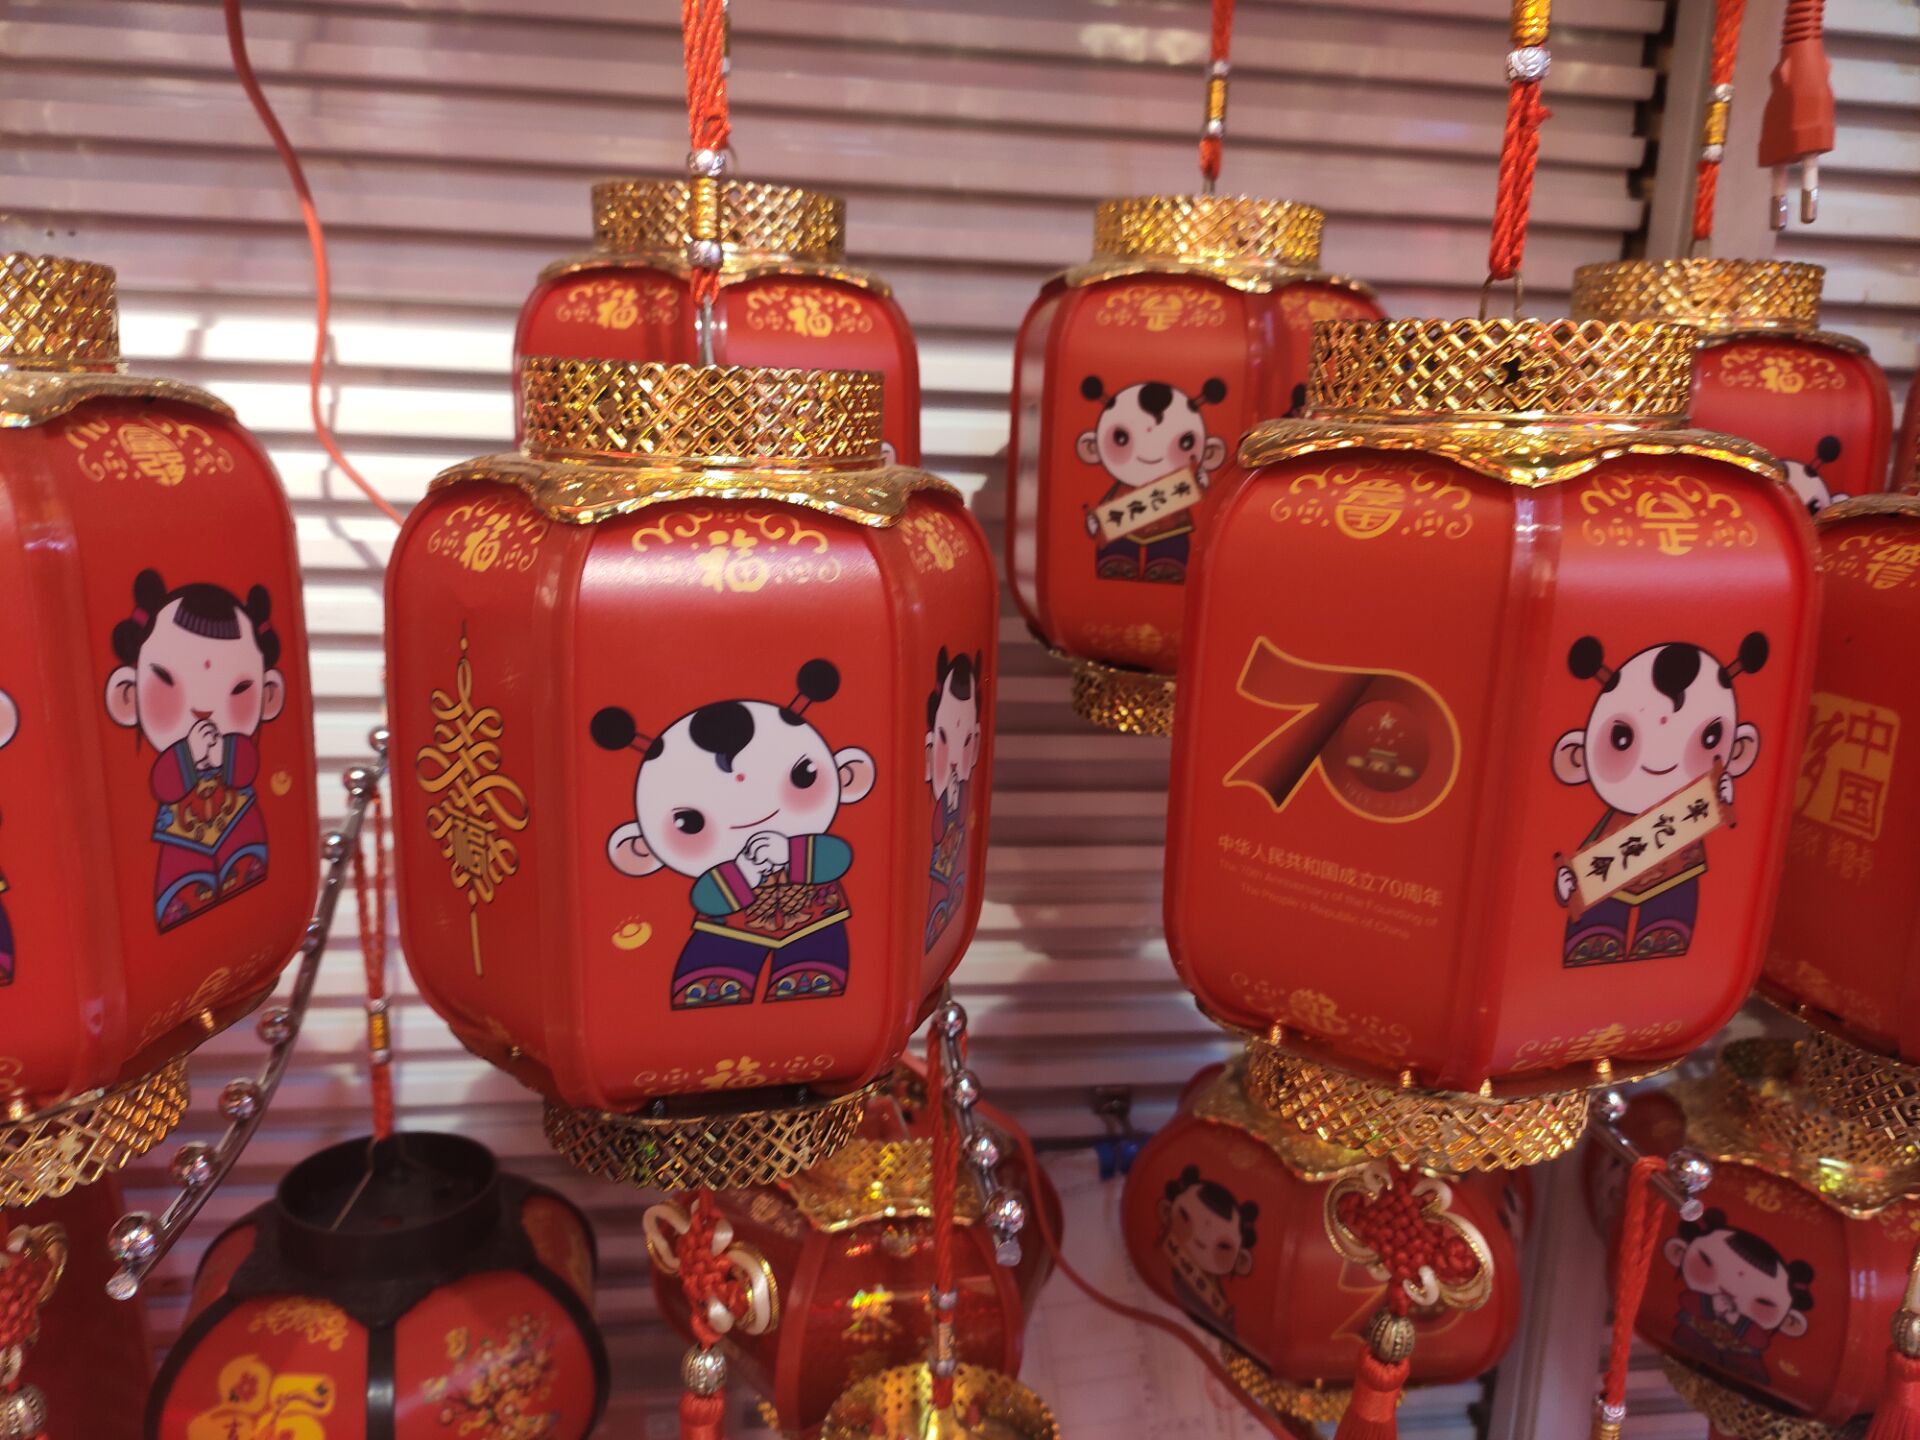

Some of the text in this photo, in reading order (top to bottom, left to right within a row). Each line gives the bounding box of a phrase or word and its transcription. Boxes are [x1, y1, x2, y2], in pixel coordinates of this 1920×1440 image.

[597, 289, 638, 330] 福
[787, 294, 833, 337] 福
[1760, 357, 1804, 393] 福
[460, 513, 511, 572] 福
[696, 529, 769, 592] 福
[916, 515, 955, 571] 福
[1222, 636, 1462, 824] 70
[1585, 798, 1710, 883] 牢记使命
[1218, 834, 1442, 907] 中华人民共和国成立70周年
